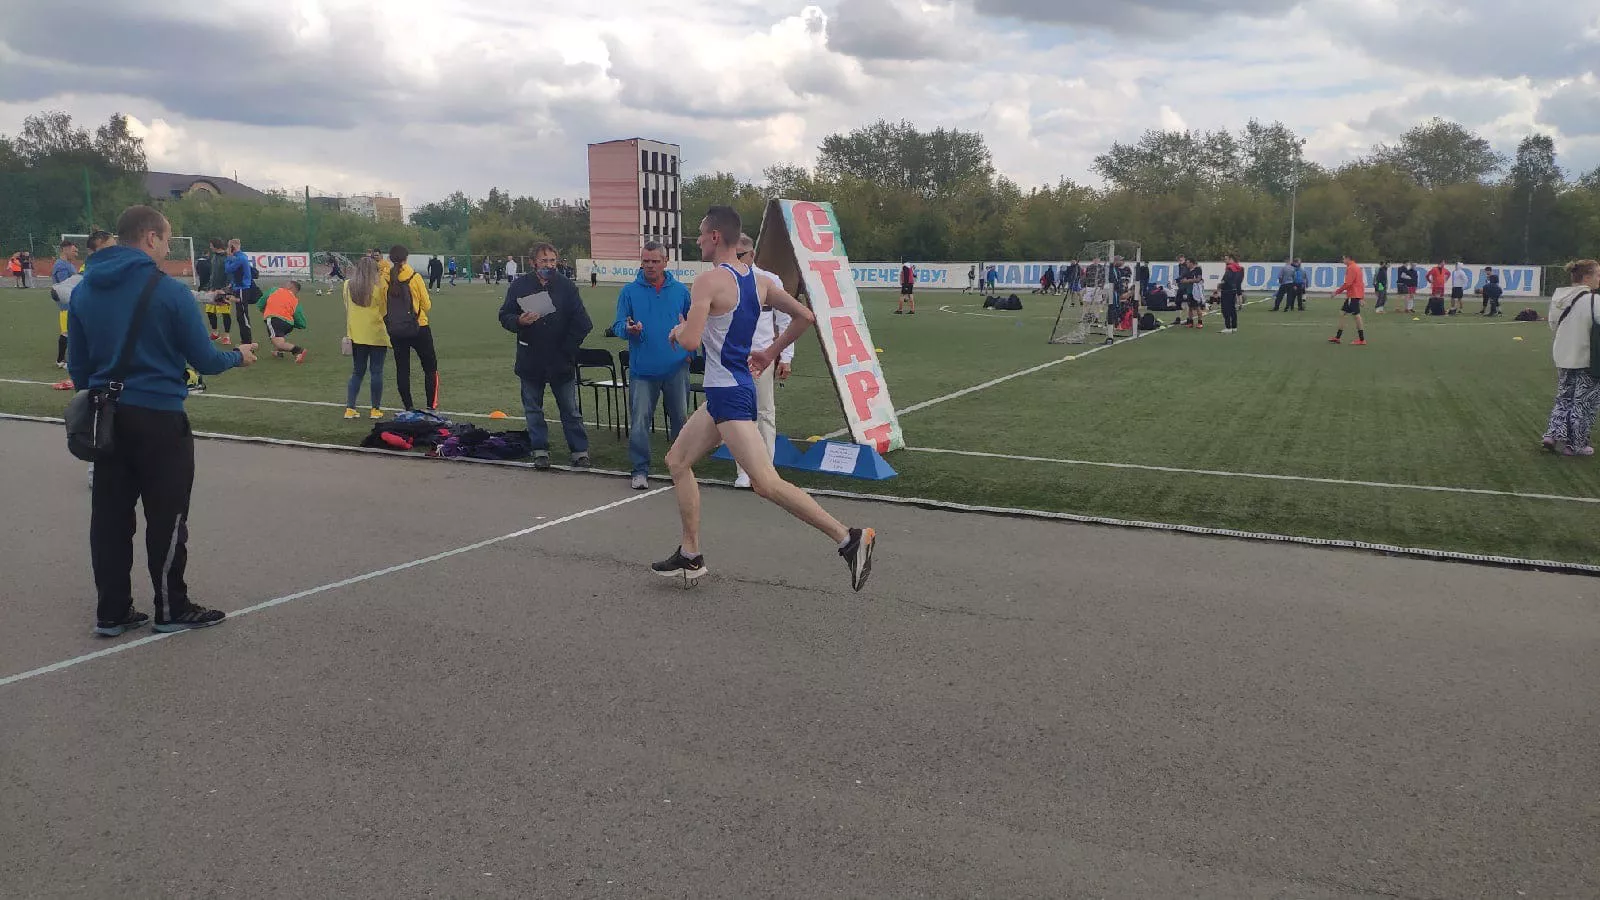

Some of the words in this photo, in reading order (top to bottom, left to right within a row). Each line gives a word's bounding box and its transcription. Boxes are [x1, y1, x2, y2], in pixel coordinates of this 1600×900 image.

[288, 256, 306, 267] ТВ
[850, 268, 947, 283] ОТЕЧЕТВУ!
[791, 201, 892, 454] СТАРТ
